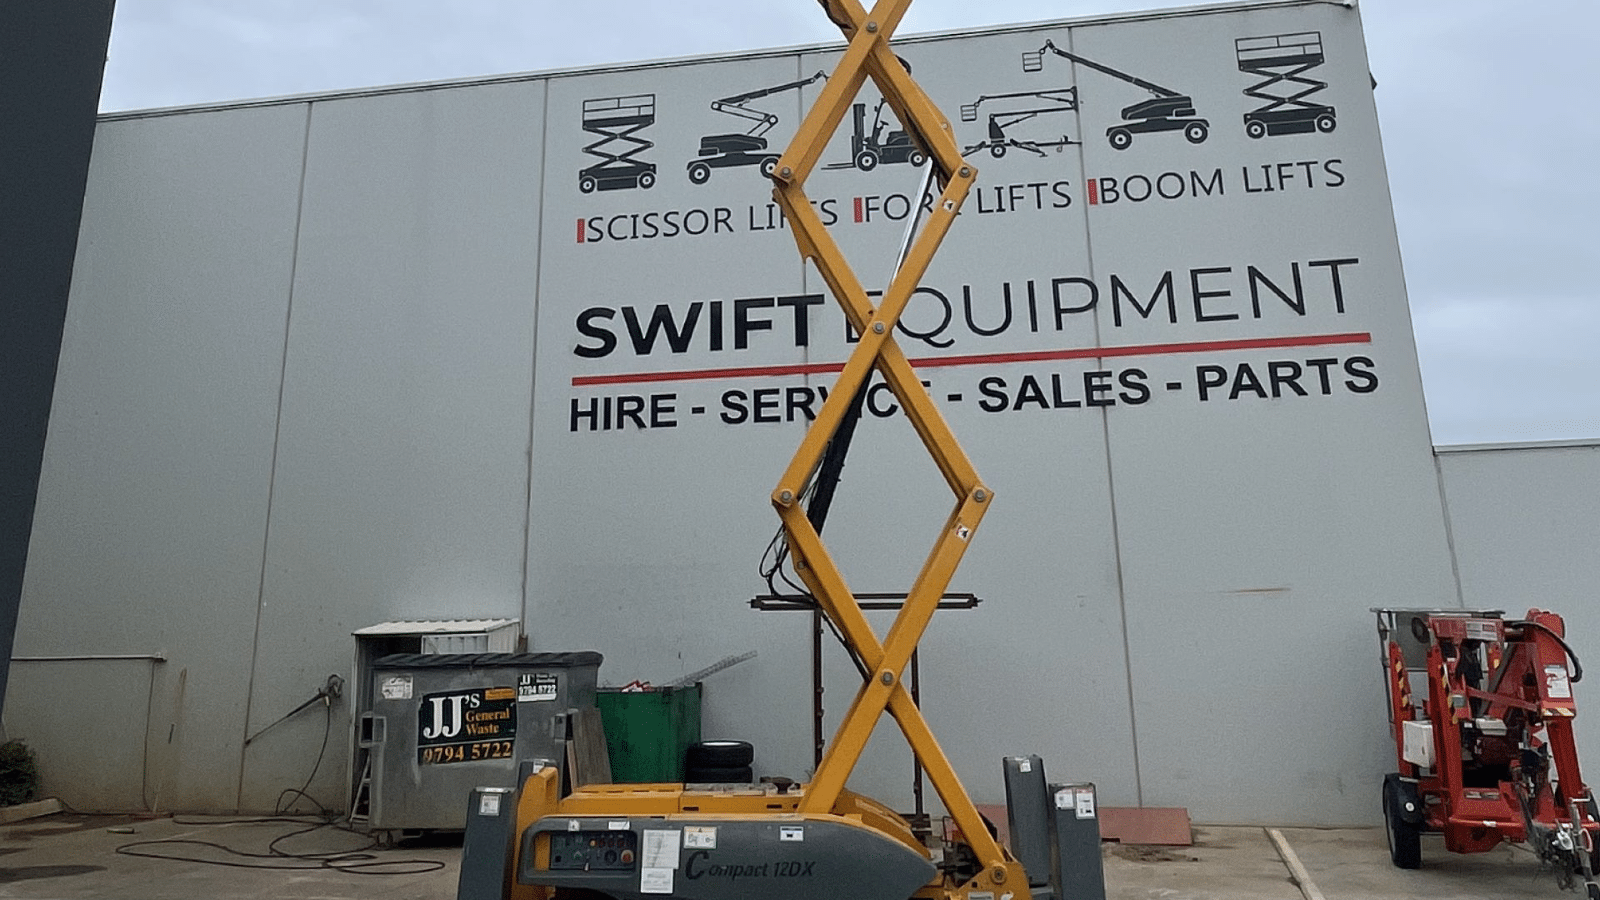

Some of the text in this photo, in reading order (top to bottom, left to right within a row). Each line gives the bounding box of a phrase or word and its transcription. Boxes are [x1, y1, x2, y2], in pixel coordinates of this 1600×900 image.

[586, 207, 734, 242] SCISSOR
[865, 192, 962, 223] FOR
[976, 180, 1072, 214] LIFTS
[1100, 168, 1225, 205] BOOM
[1242, 159, 1346, 193] LIFTS
[573, 293, 826, 358] SWIFT
[570, 393, 678, 431] HIRE
[691, 405, 705, 413] -
[947, 394, 963, 402] -
[977, 367, 1151, 413] SALES
[1166, 382, 1182, 390] -
[1196, 356, 1379, 402] PARTS
[465, 707, 511, 722] General
[465, 722, 500, 736] Waste
[423, 741, 512, 762] 9794 5722
[685, 850, 816, 880] Compact 12DX
